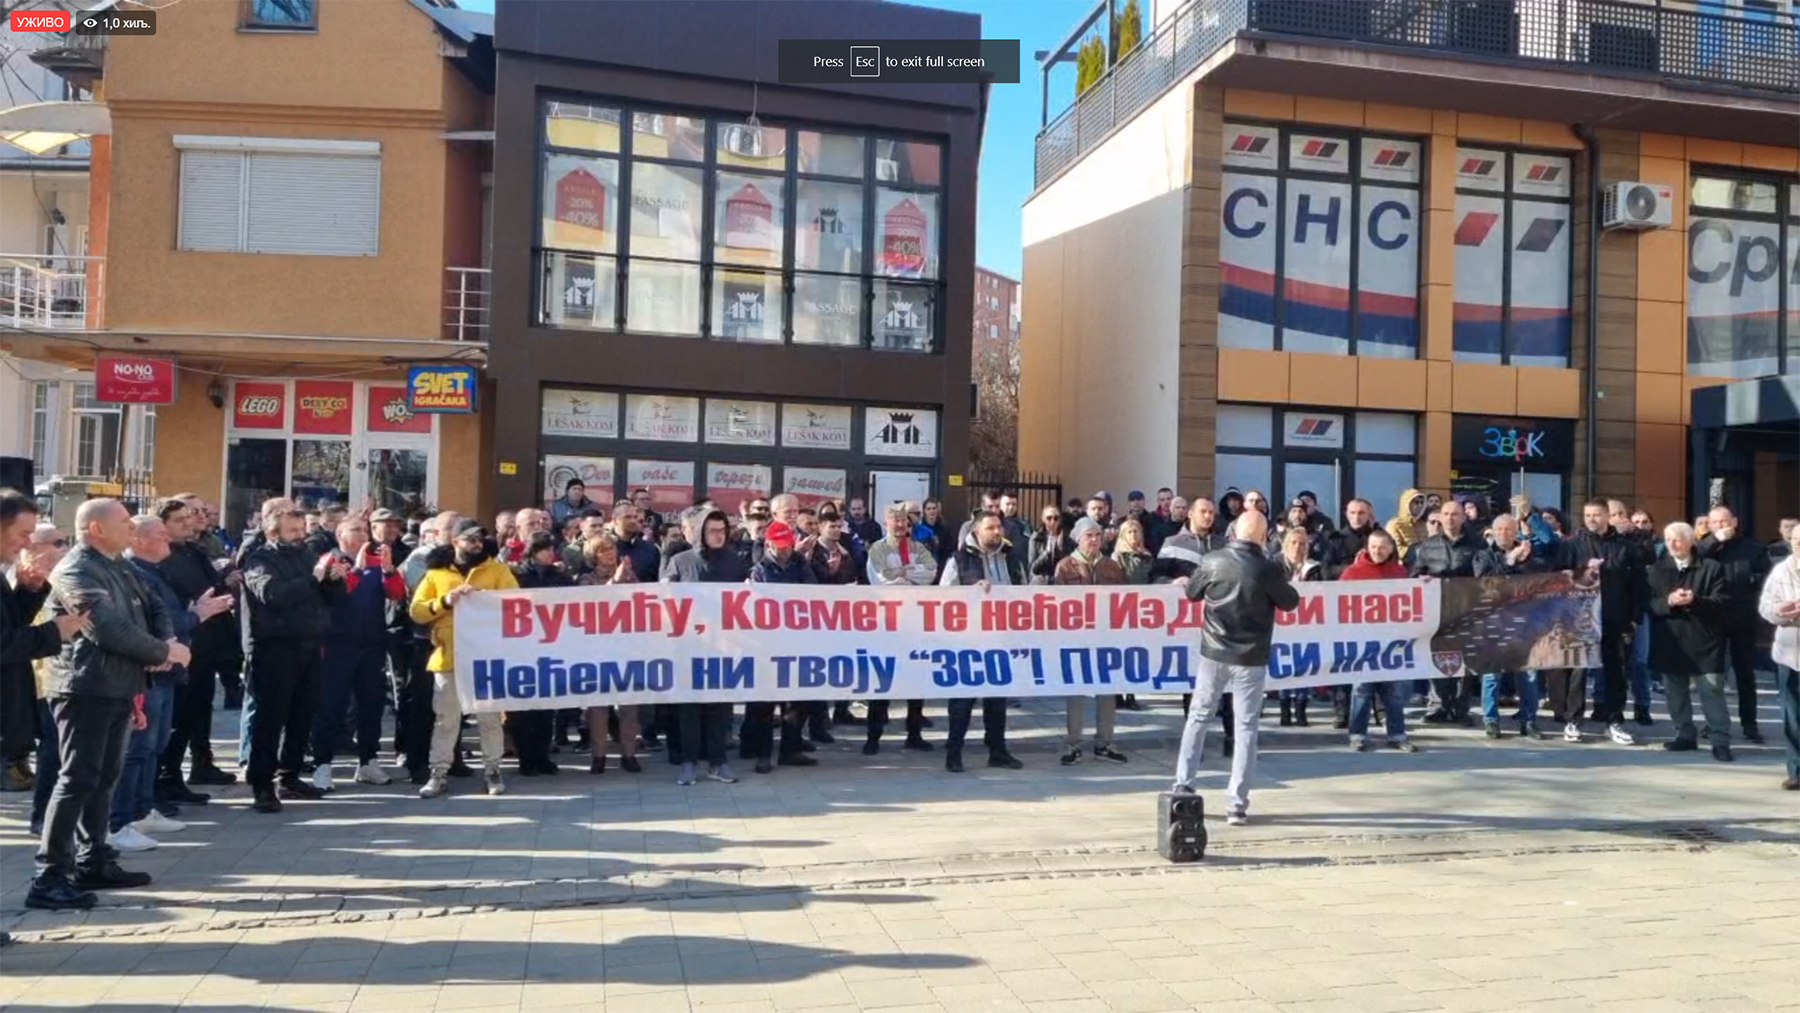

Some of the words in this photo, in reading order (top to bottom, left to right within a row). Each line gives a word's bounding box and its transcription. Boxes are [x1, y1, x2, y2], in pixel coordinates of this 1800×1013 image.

[1223, 187, 1412, 250] СНС
[1688, 218, 1800, 297] Ср
[114, 363, 153, 376] NO-NO
[413, 371, 470, 394] SVET
[241, 397, 279, 415] LEGO
[414, 393, 467, 406] IGRAČAKA
[383, 403, 414, 420] WO
[641, 465, 678, 480] vaše
[501, 590, 706, 643] Вучићу,
[720, 590, 902, 632] Космет
[917, 599, 968, 632] те
[980, 592, 1096, 632] неће!
[1338, 586, 1423, 624] нас!
[473, 655, 675, 701] Нећемо
[691, 656, 754, 691] ни
[771, 648, 896, 693] твоју
[1060, 644, 1197, 690] ПРОД
[1267, 642, 1321, 679] СИ
[1329, 638, 1418, 673] НАС!
